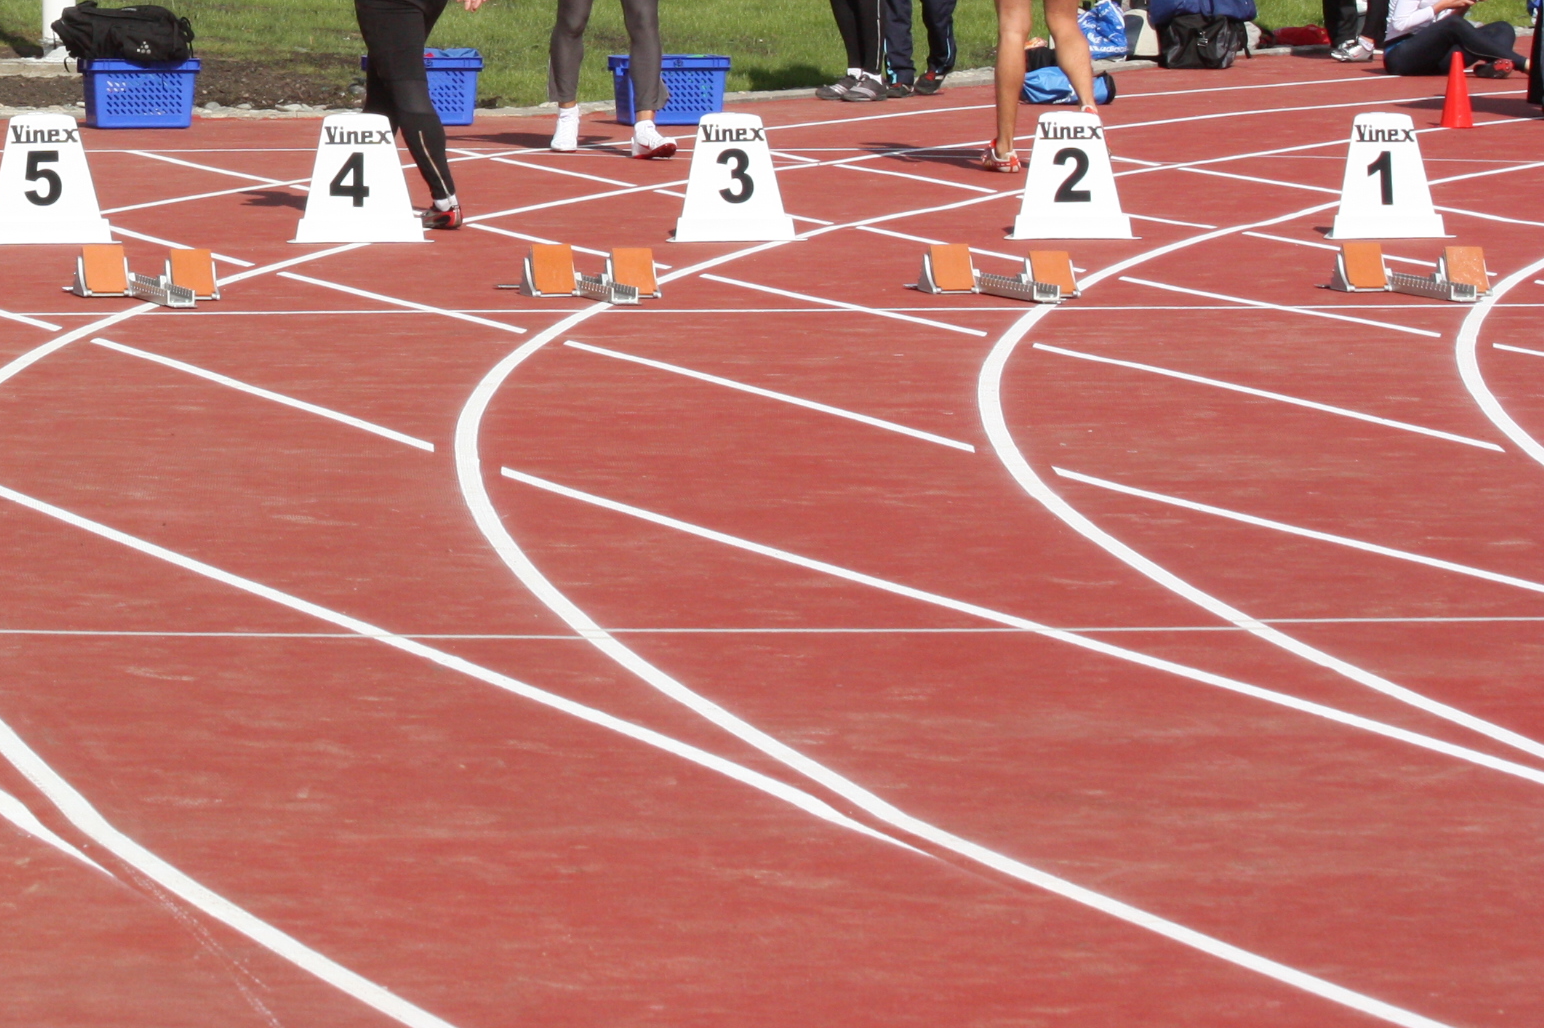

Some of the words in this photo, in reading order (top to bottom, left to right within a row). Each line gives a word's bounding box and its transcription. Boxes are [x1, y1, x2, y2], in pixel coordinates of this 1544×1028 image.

[10, 125, 78, 144] Vinex
[324, 126, 392, 145] Vinex
[699, 124, 765, 143] Vinex
[1038, 122, 1103, 140] Vinex
[1354, 124, 1415, 143] Vinex
[25, 150, 62, 206] 5
[329, 152, 370, 207] 4
[716, 148, 754, 204] 3
[1053, 147, 1091, 203] 2
[1367, 151, 1393, 205] 1
